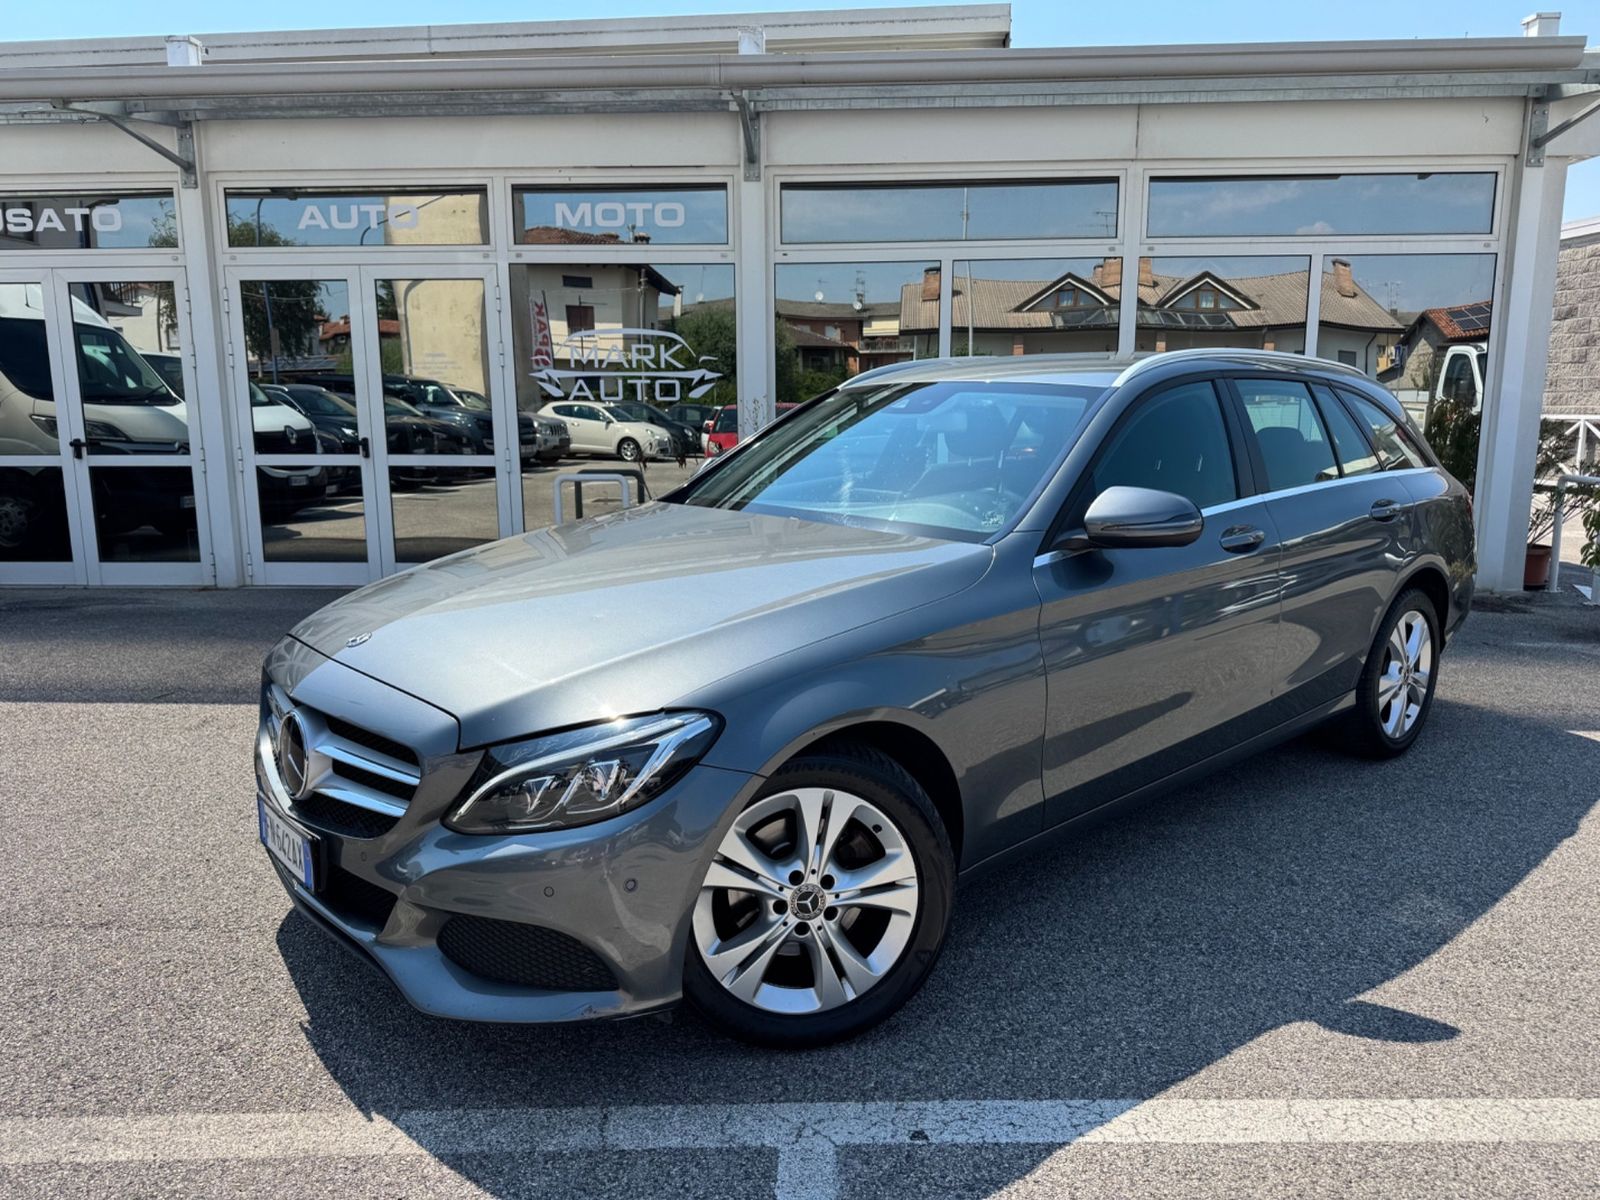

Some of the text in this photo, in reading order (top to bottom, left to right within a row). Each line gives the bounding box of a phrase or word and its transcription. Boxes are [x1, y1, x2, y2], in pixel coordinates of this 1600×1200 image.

[0, 207, 122, 232] SATO
[297, 204, 418, 229] AUTO
[554, 202, 685, 227] MOTO
[569, 344, 685, 368] MARK
[568, 379, 681, 401] AUTO
